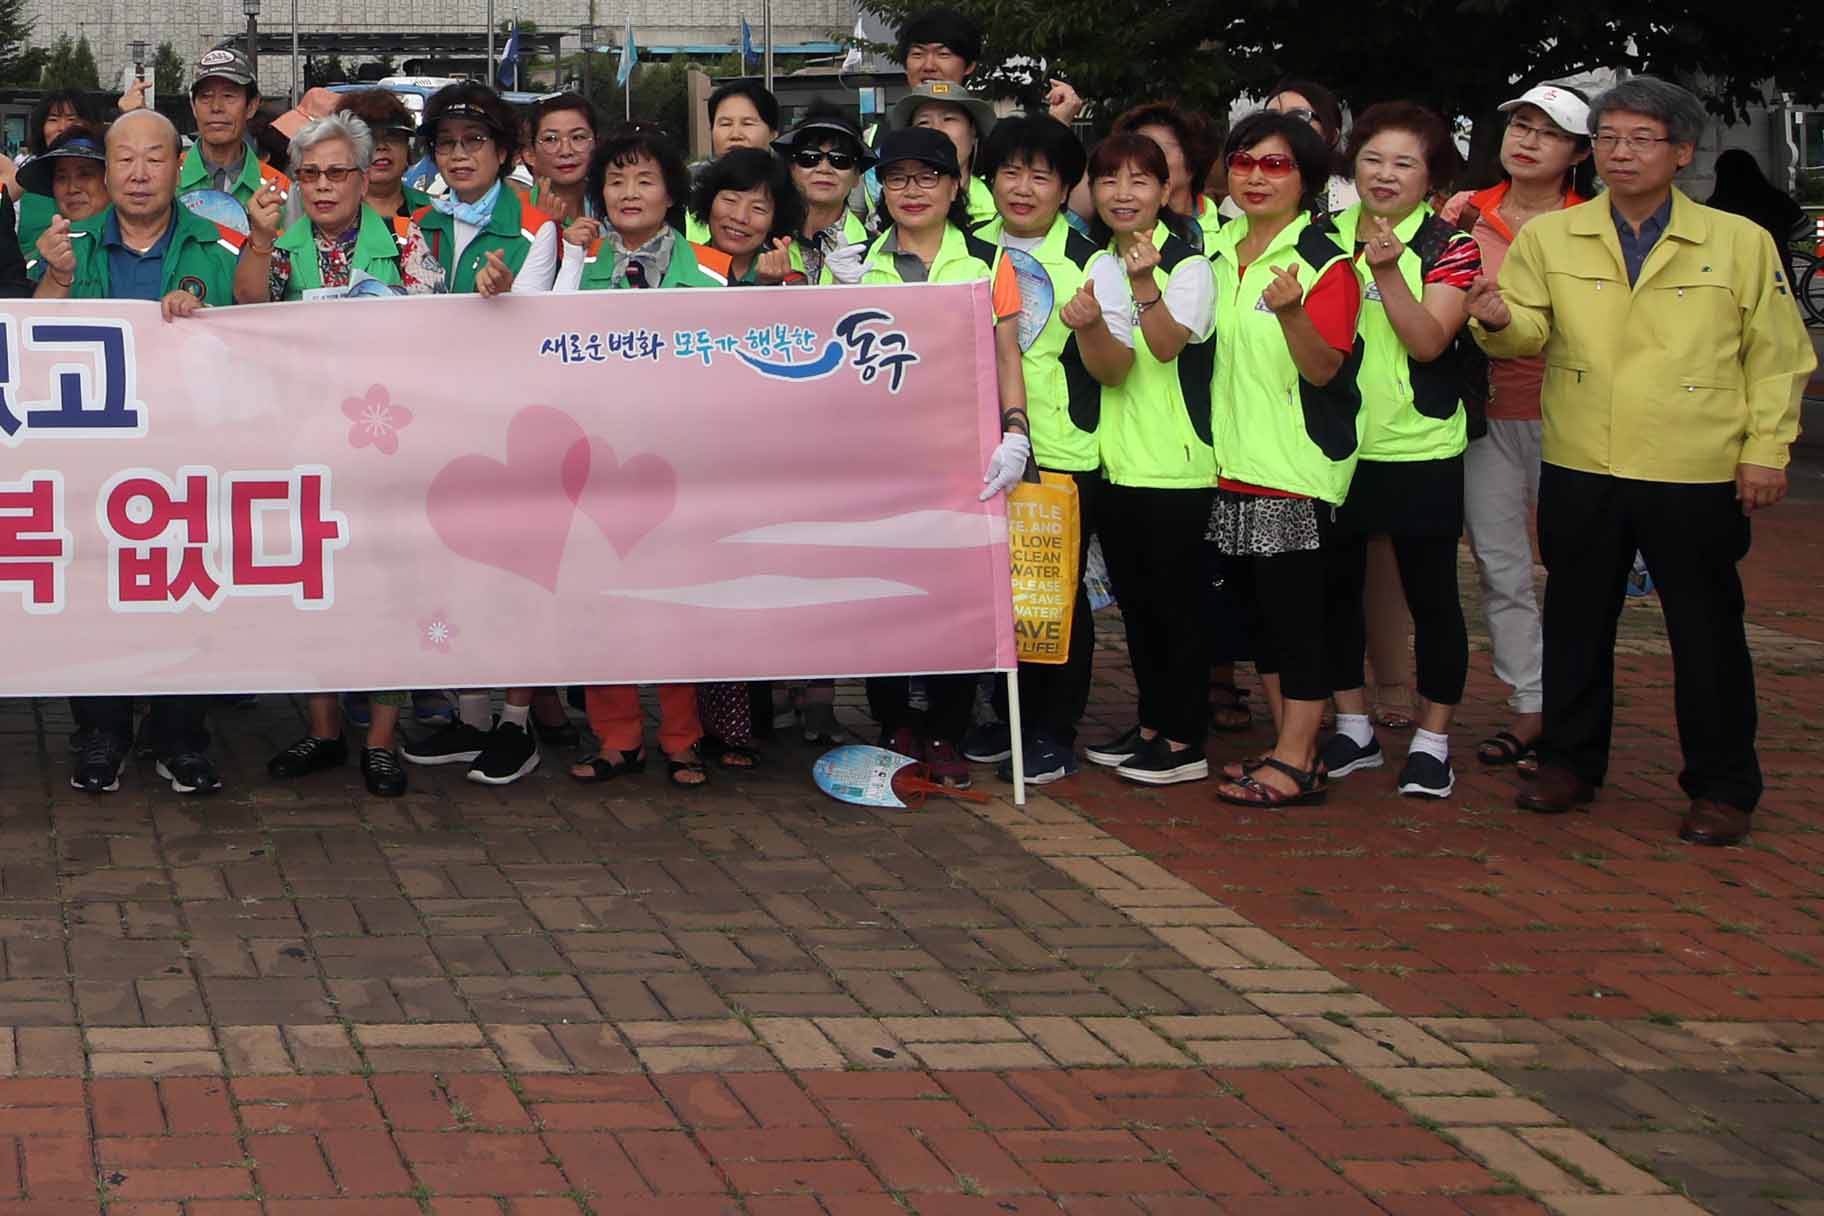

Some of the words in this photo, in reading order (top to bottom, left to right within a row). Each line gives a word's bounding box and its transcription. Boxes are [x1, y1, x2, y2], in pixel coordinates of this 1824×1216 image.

[540, 334, 606, 363] 새로운
[608, 330, 665, 360] 변화
[675, 331, 736, 364] 모두가
[745, 325, 816, 361] 행복한
[836, 311, 918, 391] 동구
[106, 474, 339, 603] 없다
[1021, 535, 1063, 549] LOVE
[1012, 549, 1062, 564] CLEAN
[1012, 578, 1063, 593] PLEASE
